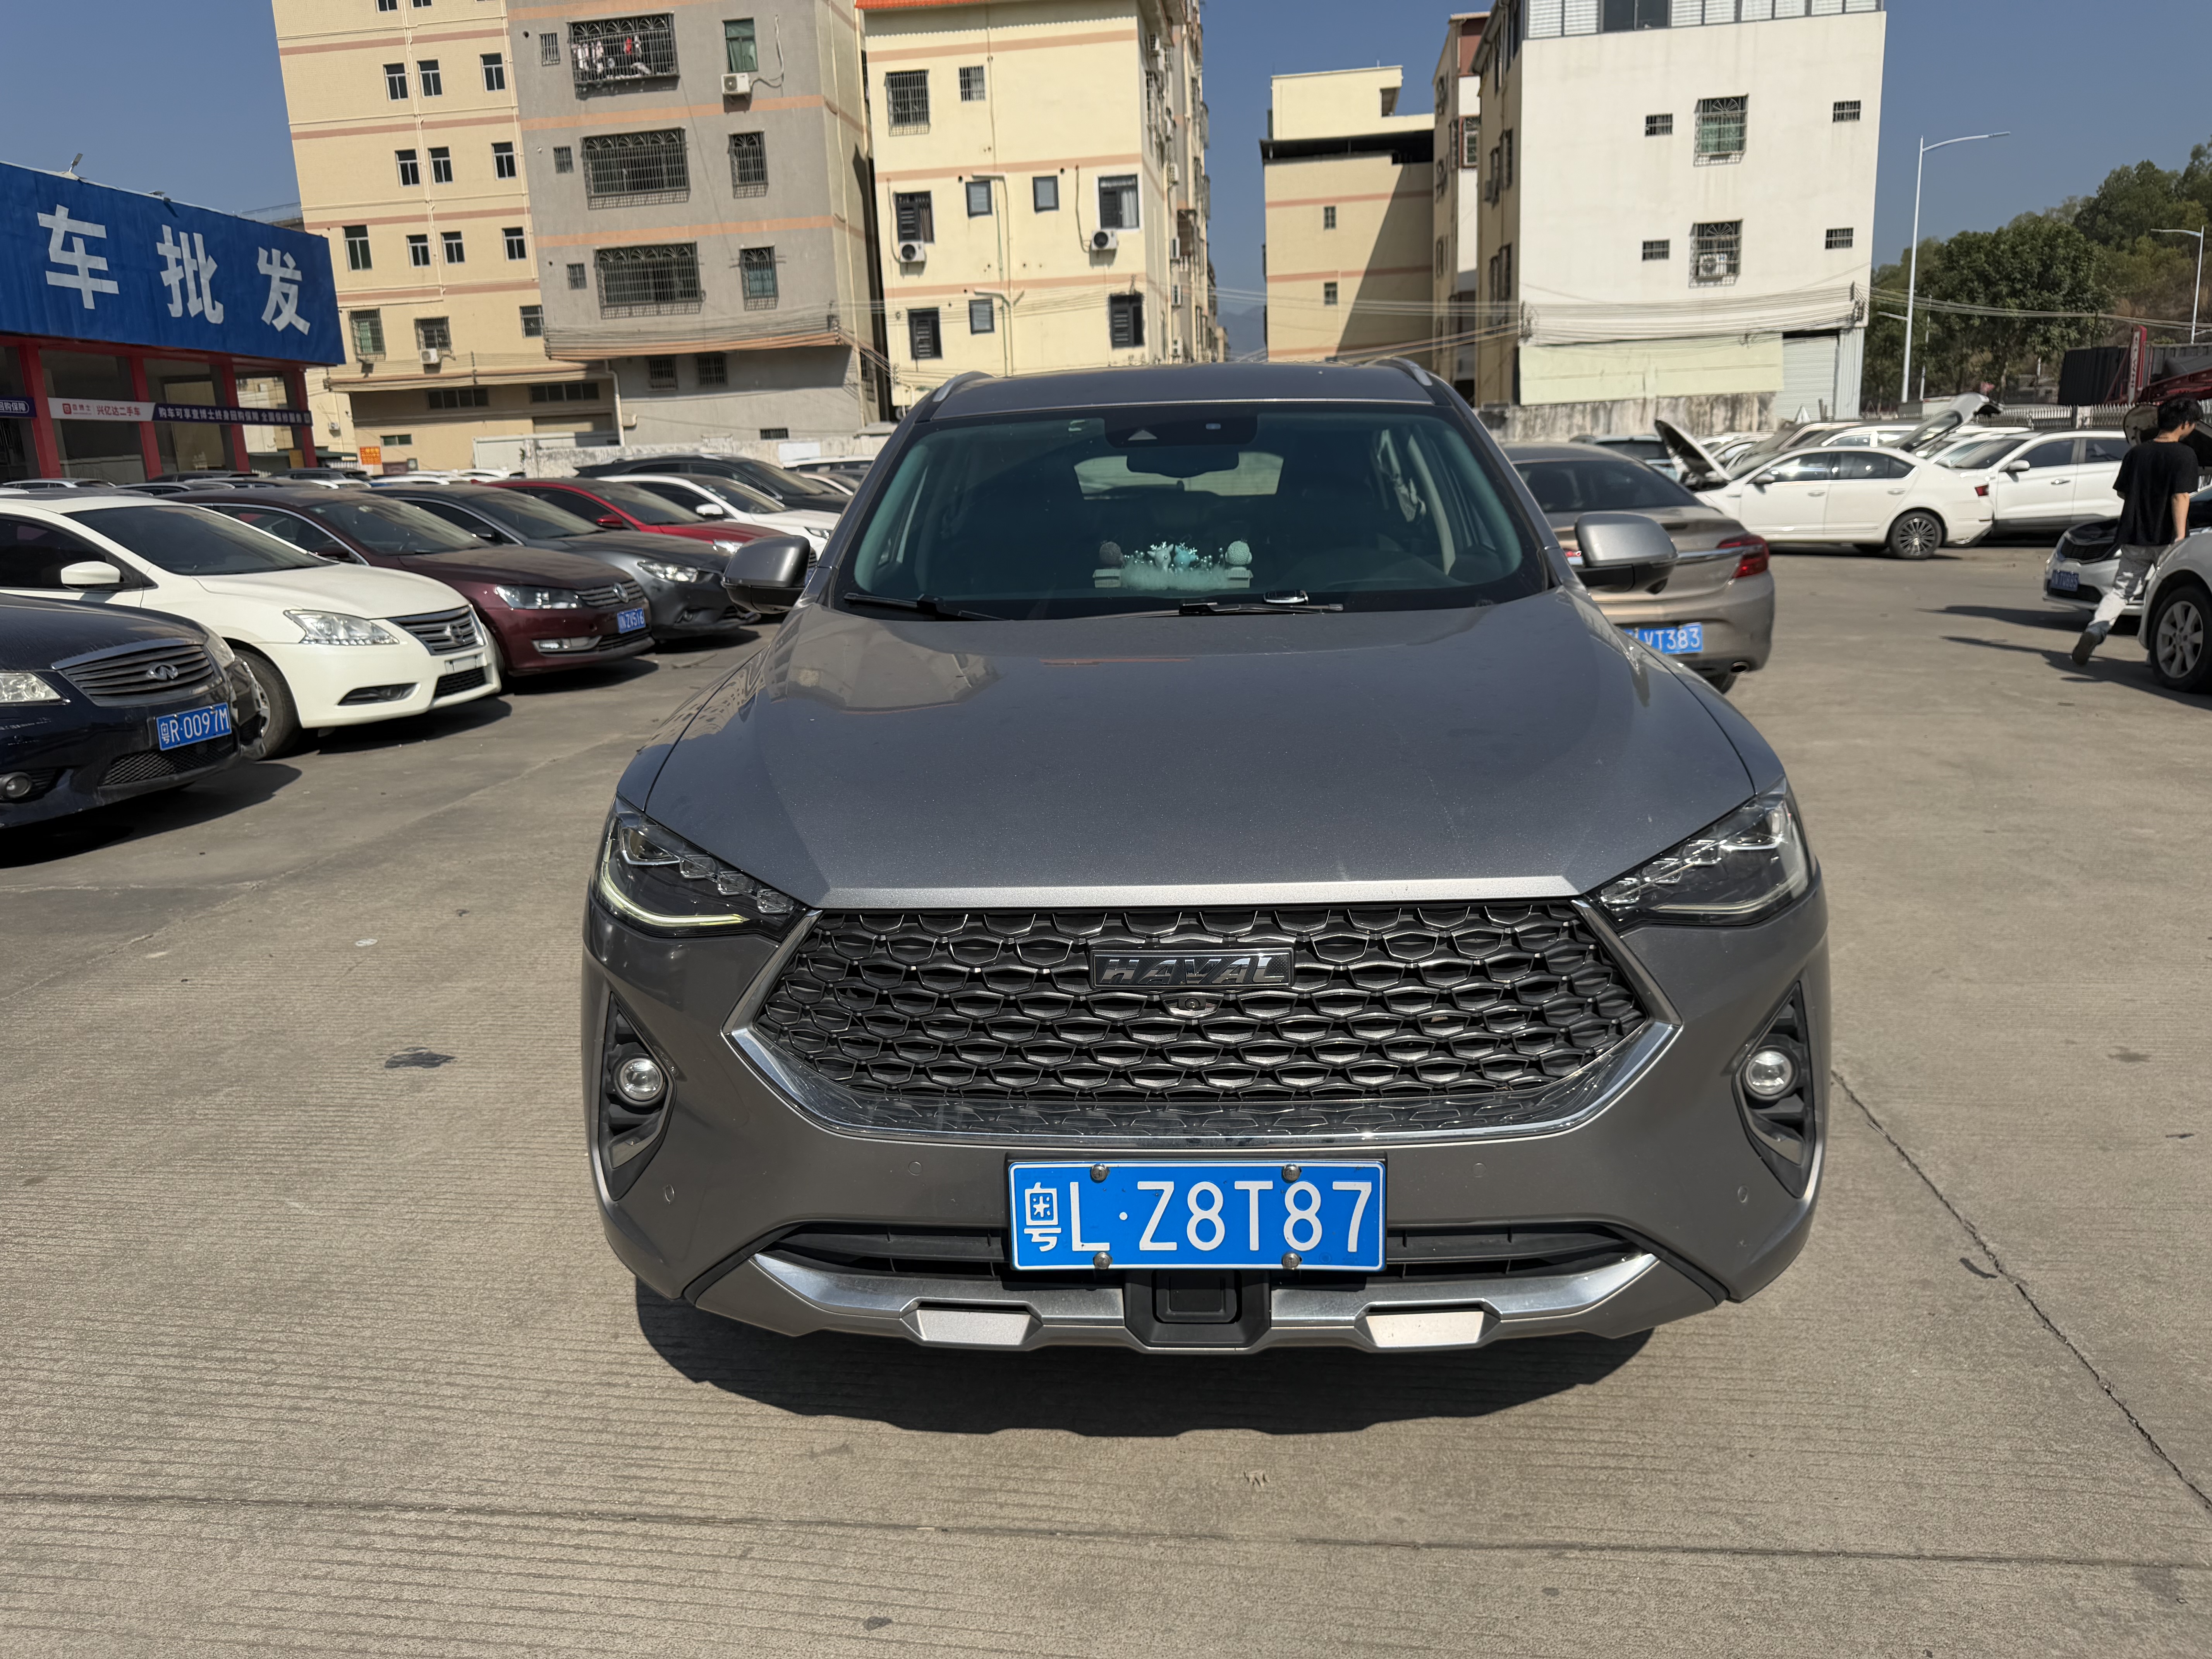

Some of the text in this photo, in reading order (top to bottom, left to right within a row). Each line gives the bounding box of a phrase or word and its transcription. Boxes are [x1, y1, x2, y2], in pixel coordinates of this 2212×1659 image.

[37, 204, 310, 335] 车批发
[1100, 957, 1285, 984] HAVAL
[1024, 1181, 1372, 1252] 粤L·Z8T87
